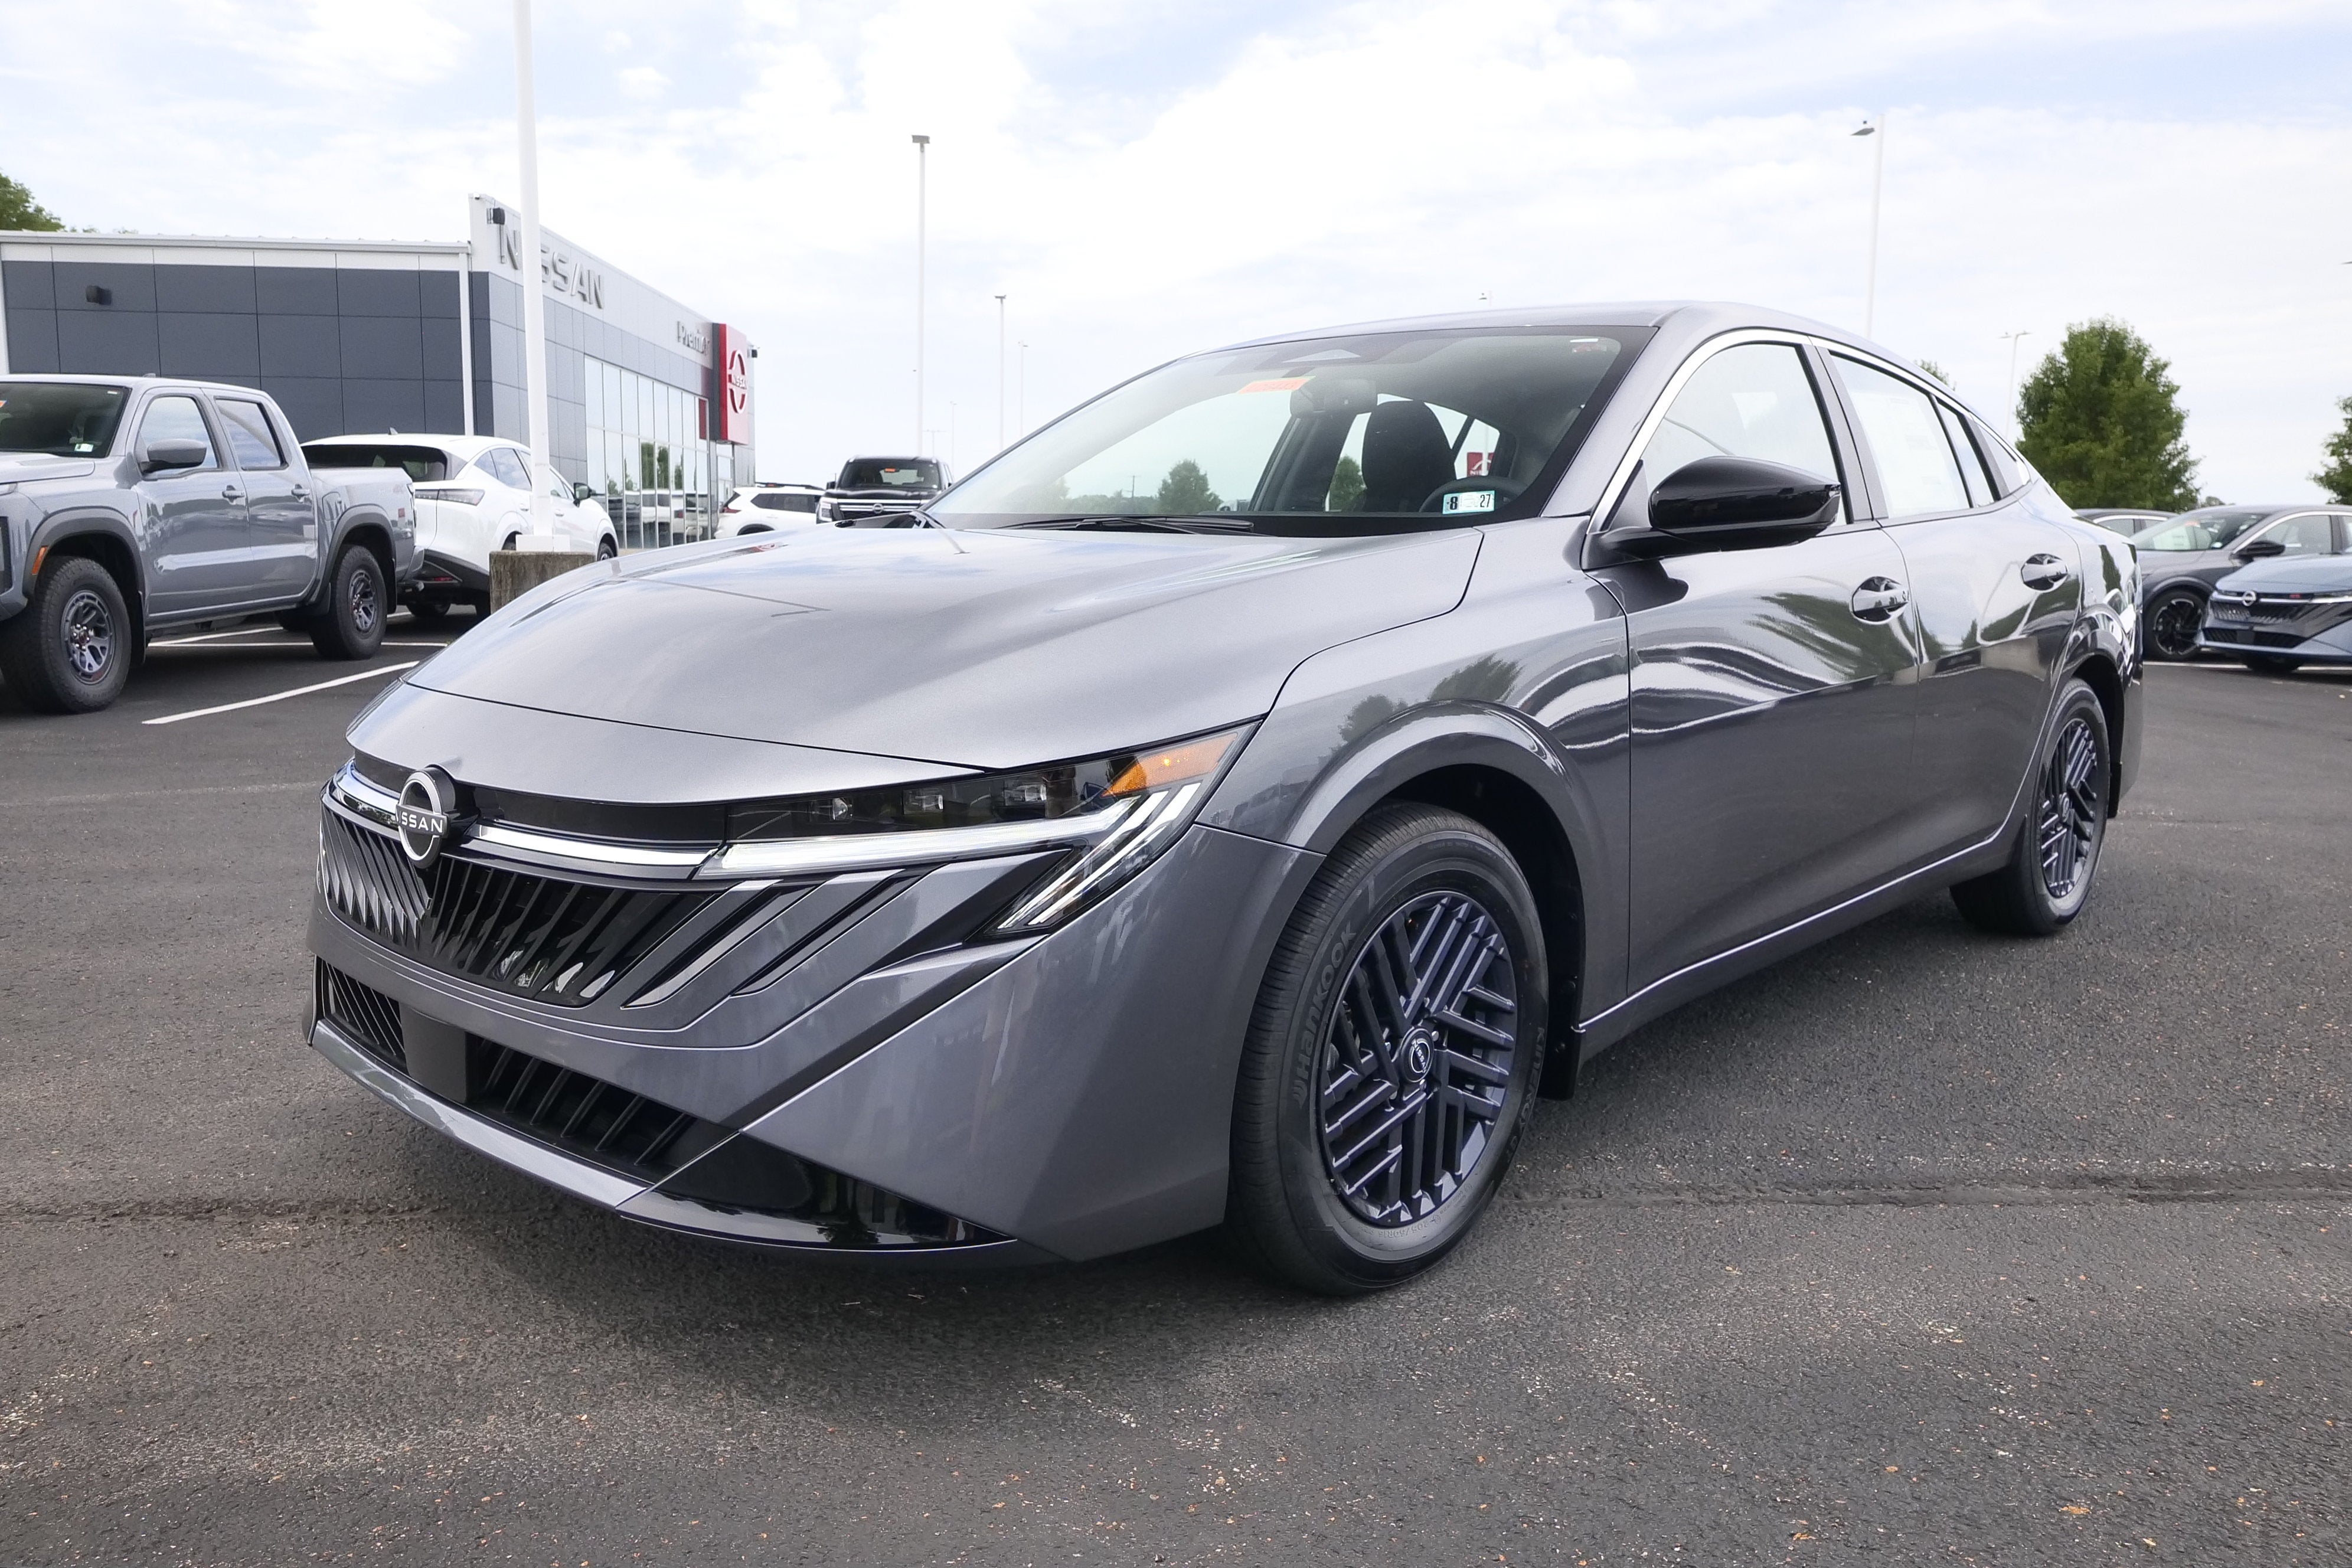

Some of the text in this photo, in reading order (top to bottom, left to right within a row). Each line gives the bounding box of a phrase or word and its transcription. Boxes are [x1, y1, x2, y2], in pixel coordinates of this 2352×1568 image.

[499, 224, 605, 309] NSSAN
[1450, 496, 1458, 510] 8
[1480, 494, 1491, 508] 27
